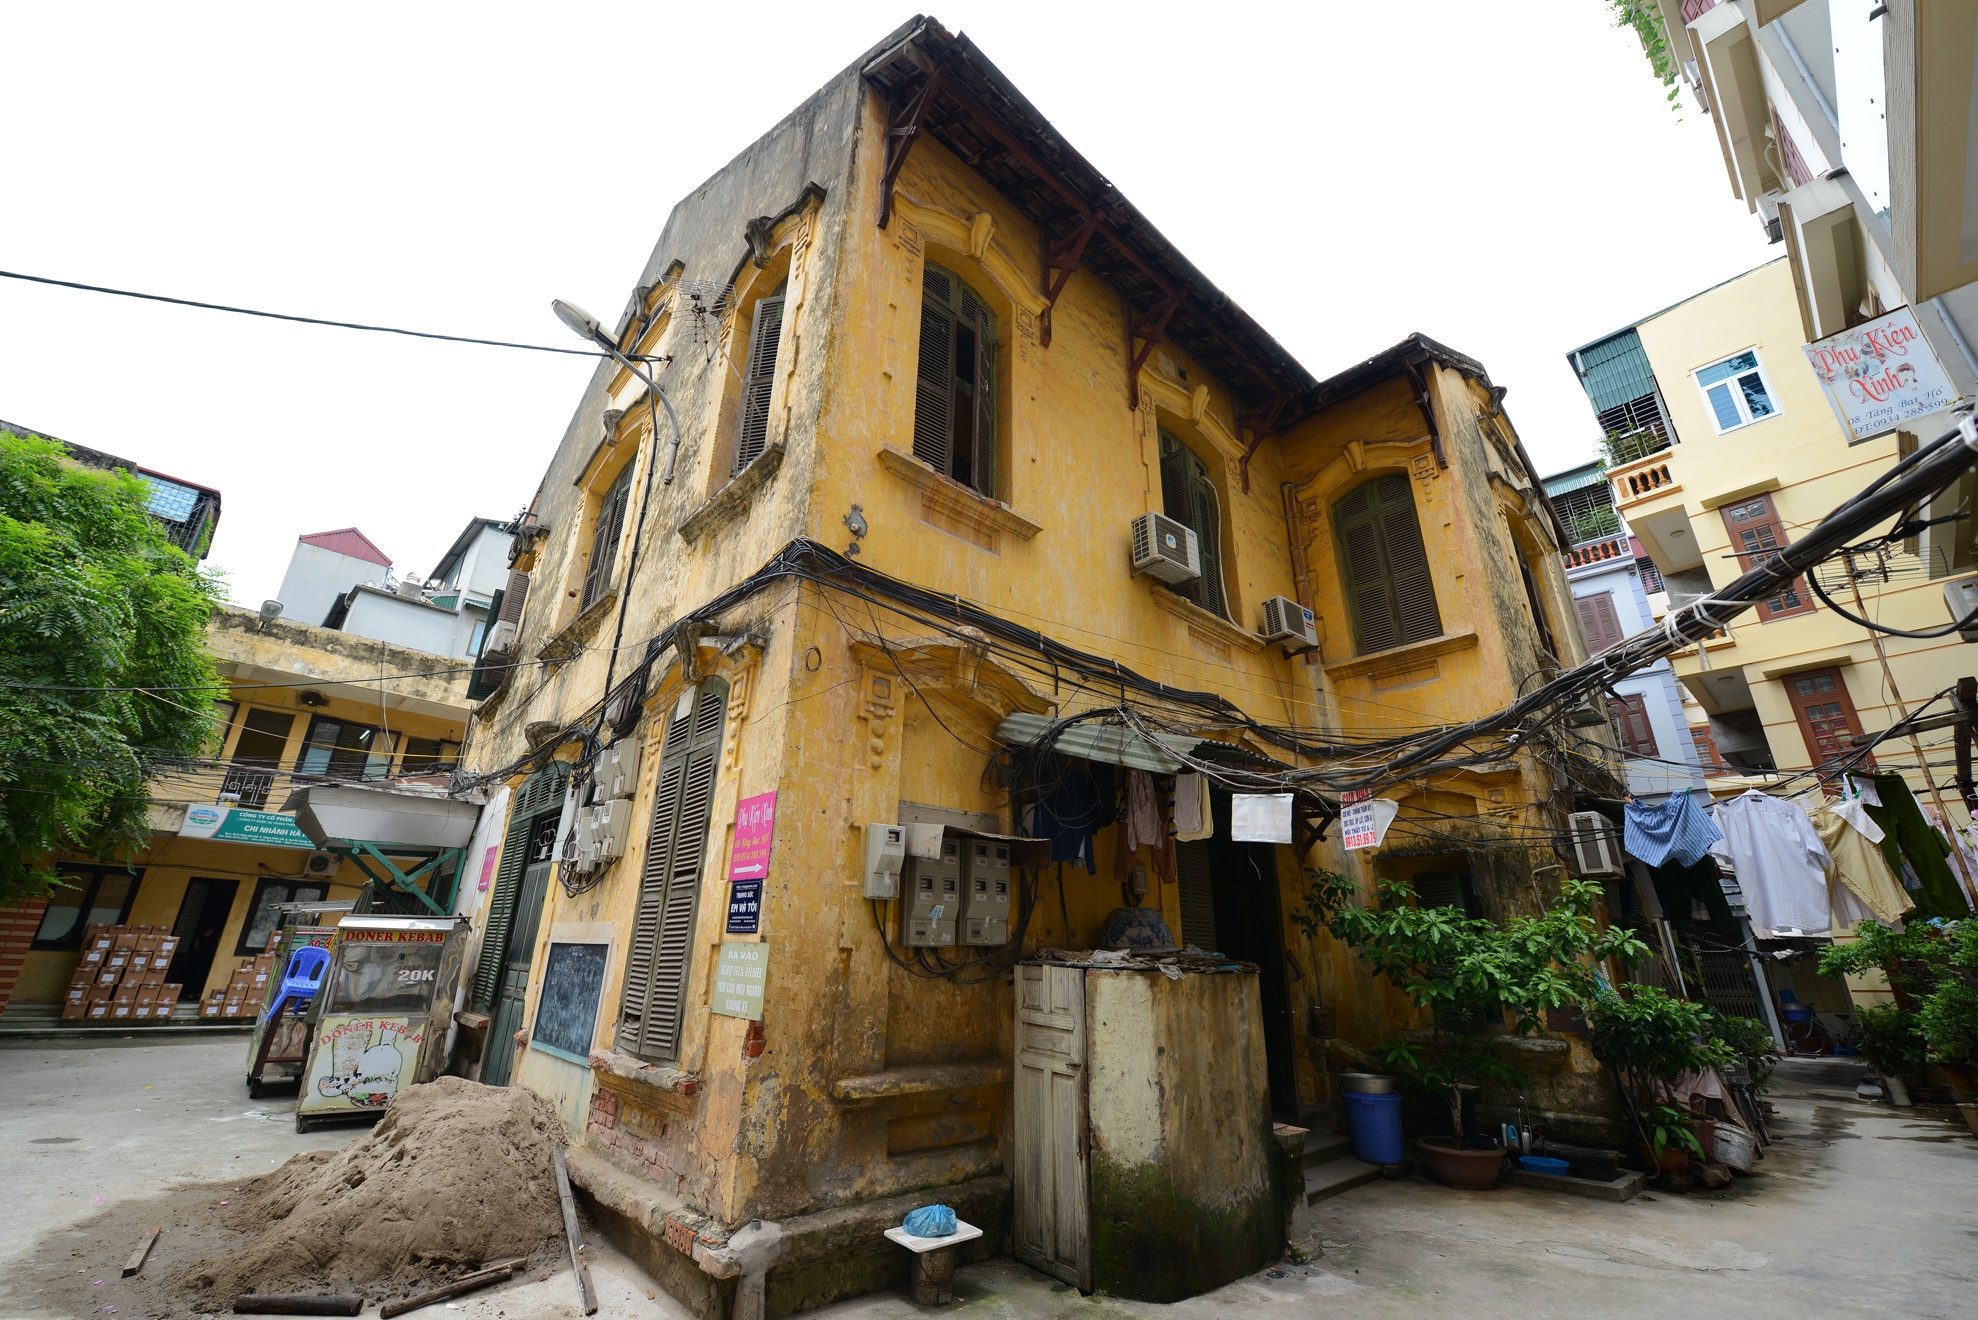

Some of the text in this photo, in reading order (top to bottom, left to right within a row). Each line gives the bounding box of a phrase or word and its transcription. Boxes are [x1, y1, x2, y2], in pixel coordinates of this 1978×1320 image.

[1812, 322, 1917, 383] Phụ Kiện
[1848, 366, 1904, 404] Xinh
[1848, 415, 1861, 425] 08
[259, 826, 289, 836] NHÁNH
[289, 828, 301, 837] HÀ
[730, 903, 738, 913] EM
[747, 901, 757, 913] TÔI
[345, 931, 394, 942] DONER
[397, 932, 444, 943] KEBAB
[728, 948, 758, 960] RA VÀO
[397, 969, 435, 981] 20K
[721, 965, 762, 978] KHU GIA ĐÌNH
[741, 1000, 749, 1013] XE
[320, 1021, 422, 1046] DÖNER KEBB
